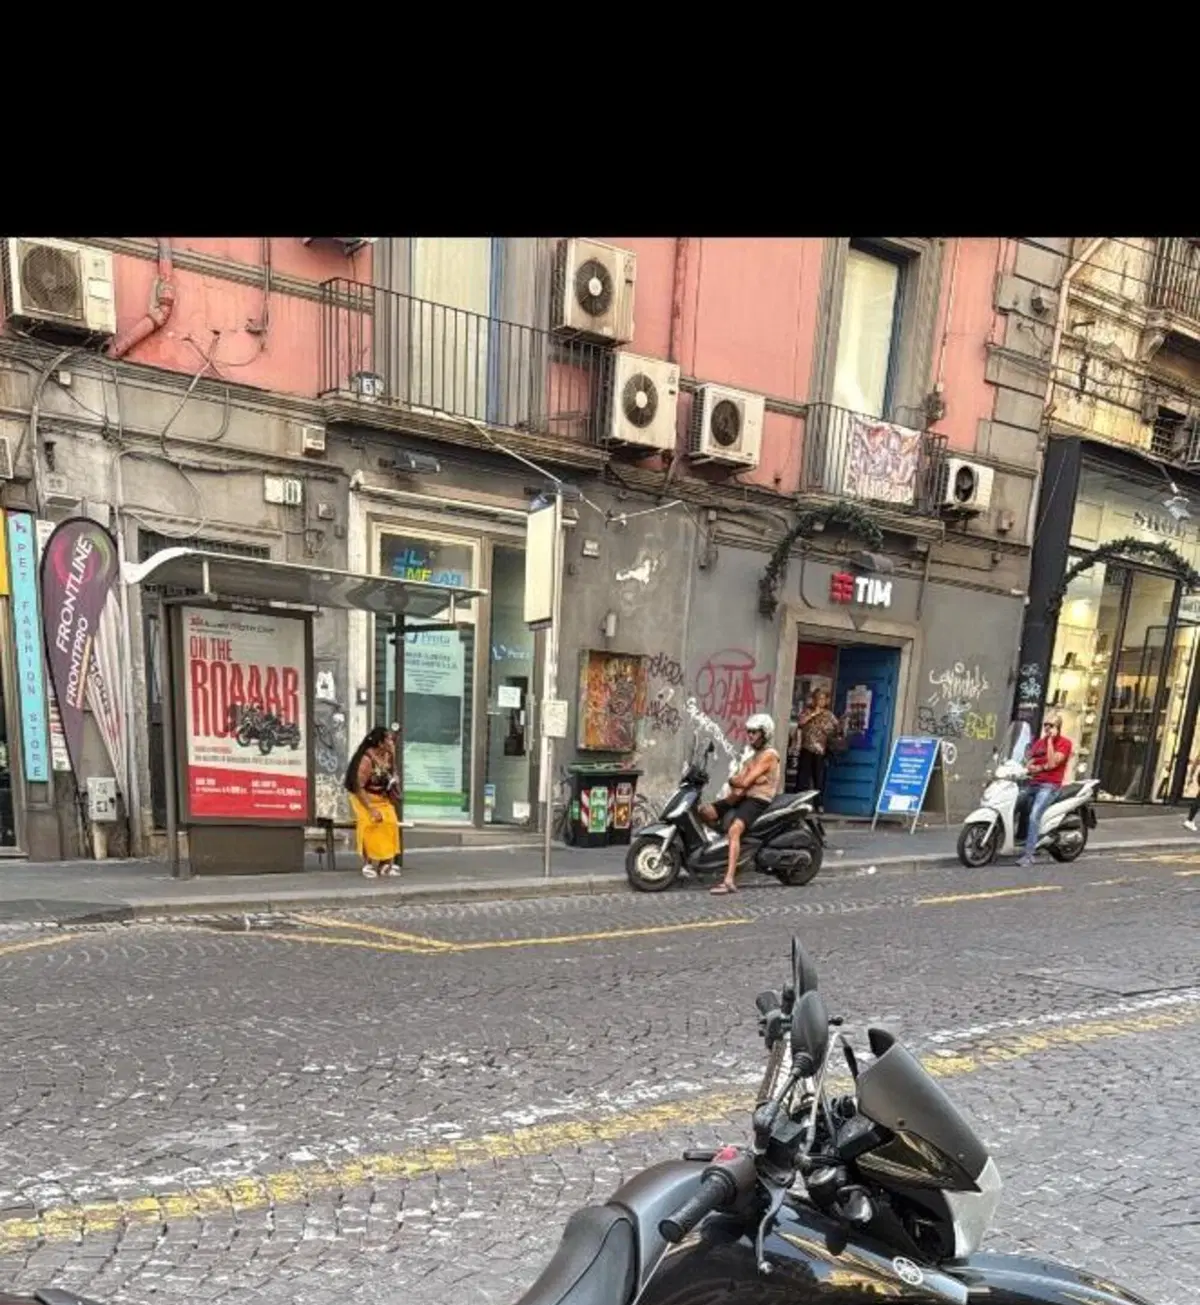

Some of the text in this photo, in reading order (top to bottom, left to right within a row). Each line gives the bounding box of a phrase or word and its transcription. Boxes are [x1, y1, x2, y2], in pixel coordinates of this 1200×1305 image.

[56, 533, 94, 654] FRONTLINE
[855, 575, 893, 608] TIM
[66, 616, 88, 708] FRONTPRO
[190, 635, 233, 661] ON THE
[190, 659, 300, 738] ROAAAR
